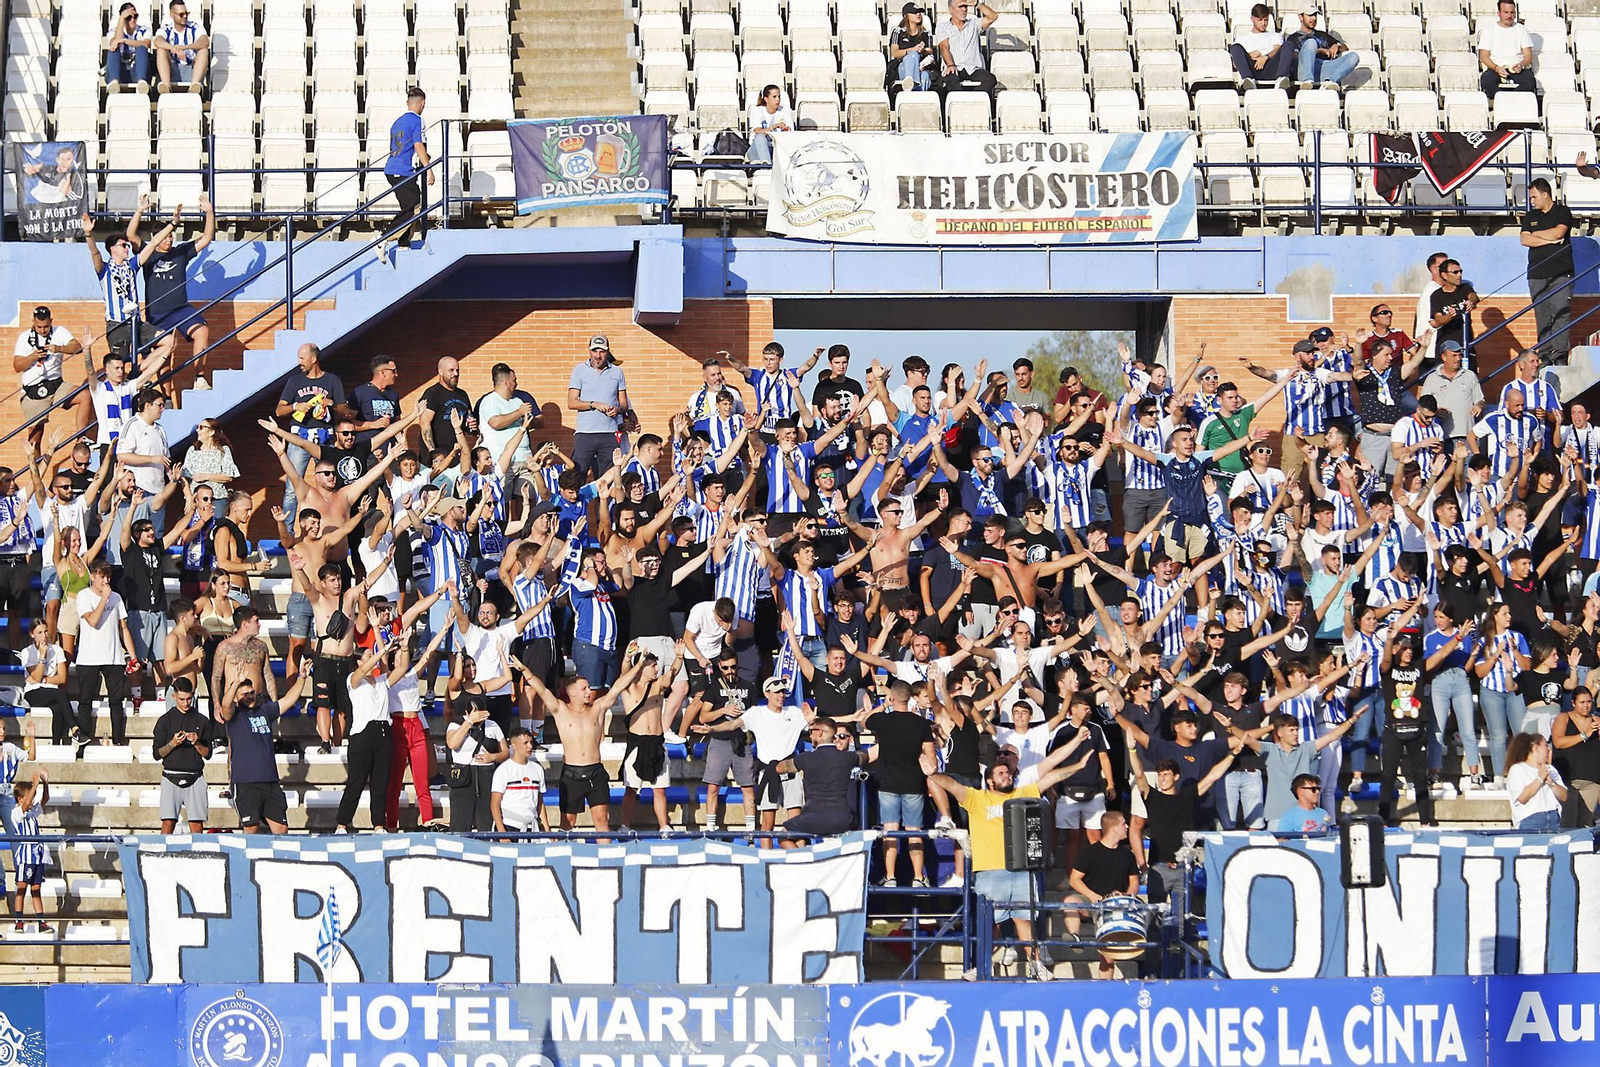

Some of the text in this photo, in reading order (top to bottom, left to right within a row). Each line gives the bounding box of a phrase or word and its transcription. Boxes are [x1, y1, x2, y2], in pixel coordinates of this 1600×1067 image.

[545, 119, 632, 139] PELOTÓN
[984, 142, 1090, 165] SECTOR
[541, 171, 650, 198] PANSARCÓ
[896, 166, 1180, 210] HELICÓSTERO
[29, 205, 78, 221] LA MORTE
[828, 217, 866, 233] Gol Sur
[24, 223, 41, 234] NON
[43, 220, 50, 233] È
[52, 221, 64, 233] LA
[944, 221, 998, 233] DECANO
[1004, 221, 1027, 232] DEL
[139, 850, 868, 984] FRENTE
[194, 1001, 280, 1039] MARTÍN ALONSO PINZÓN
[321, 986, 795, 1042] HOTEL MARTÍN
[1505, 991, 1600, 1043] Au
[972, 1003, 1468, 1067] ATRACCIONES LA CINTA
